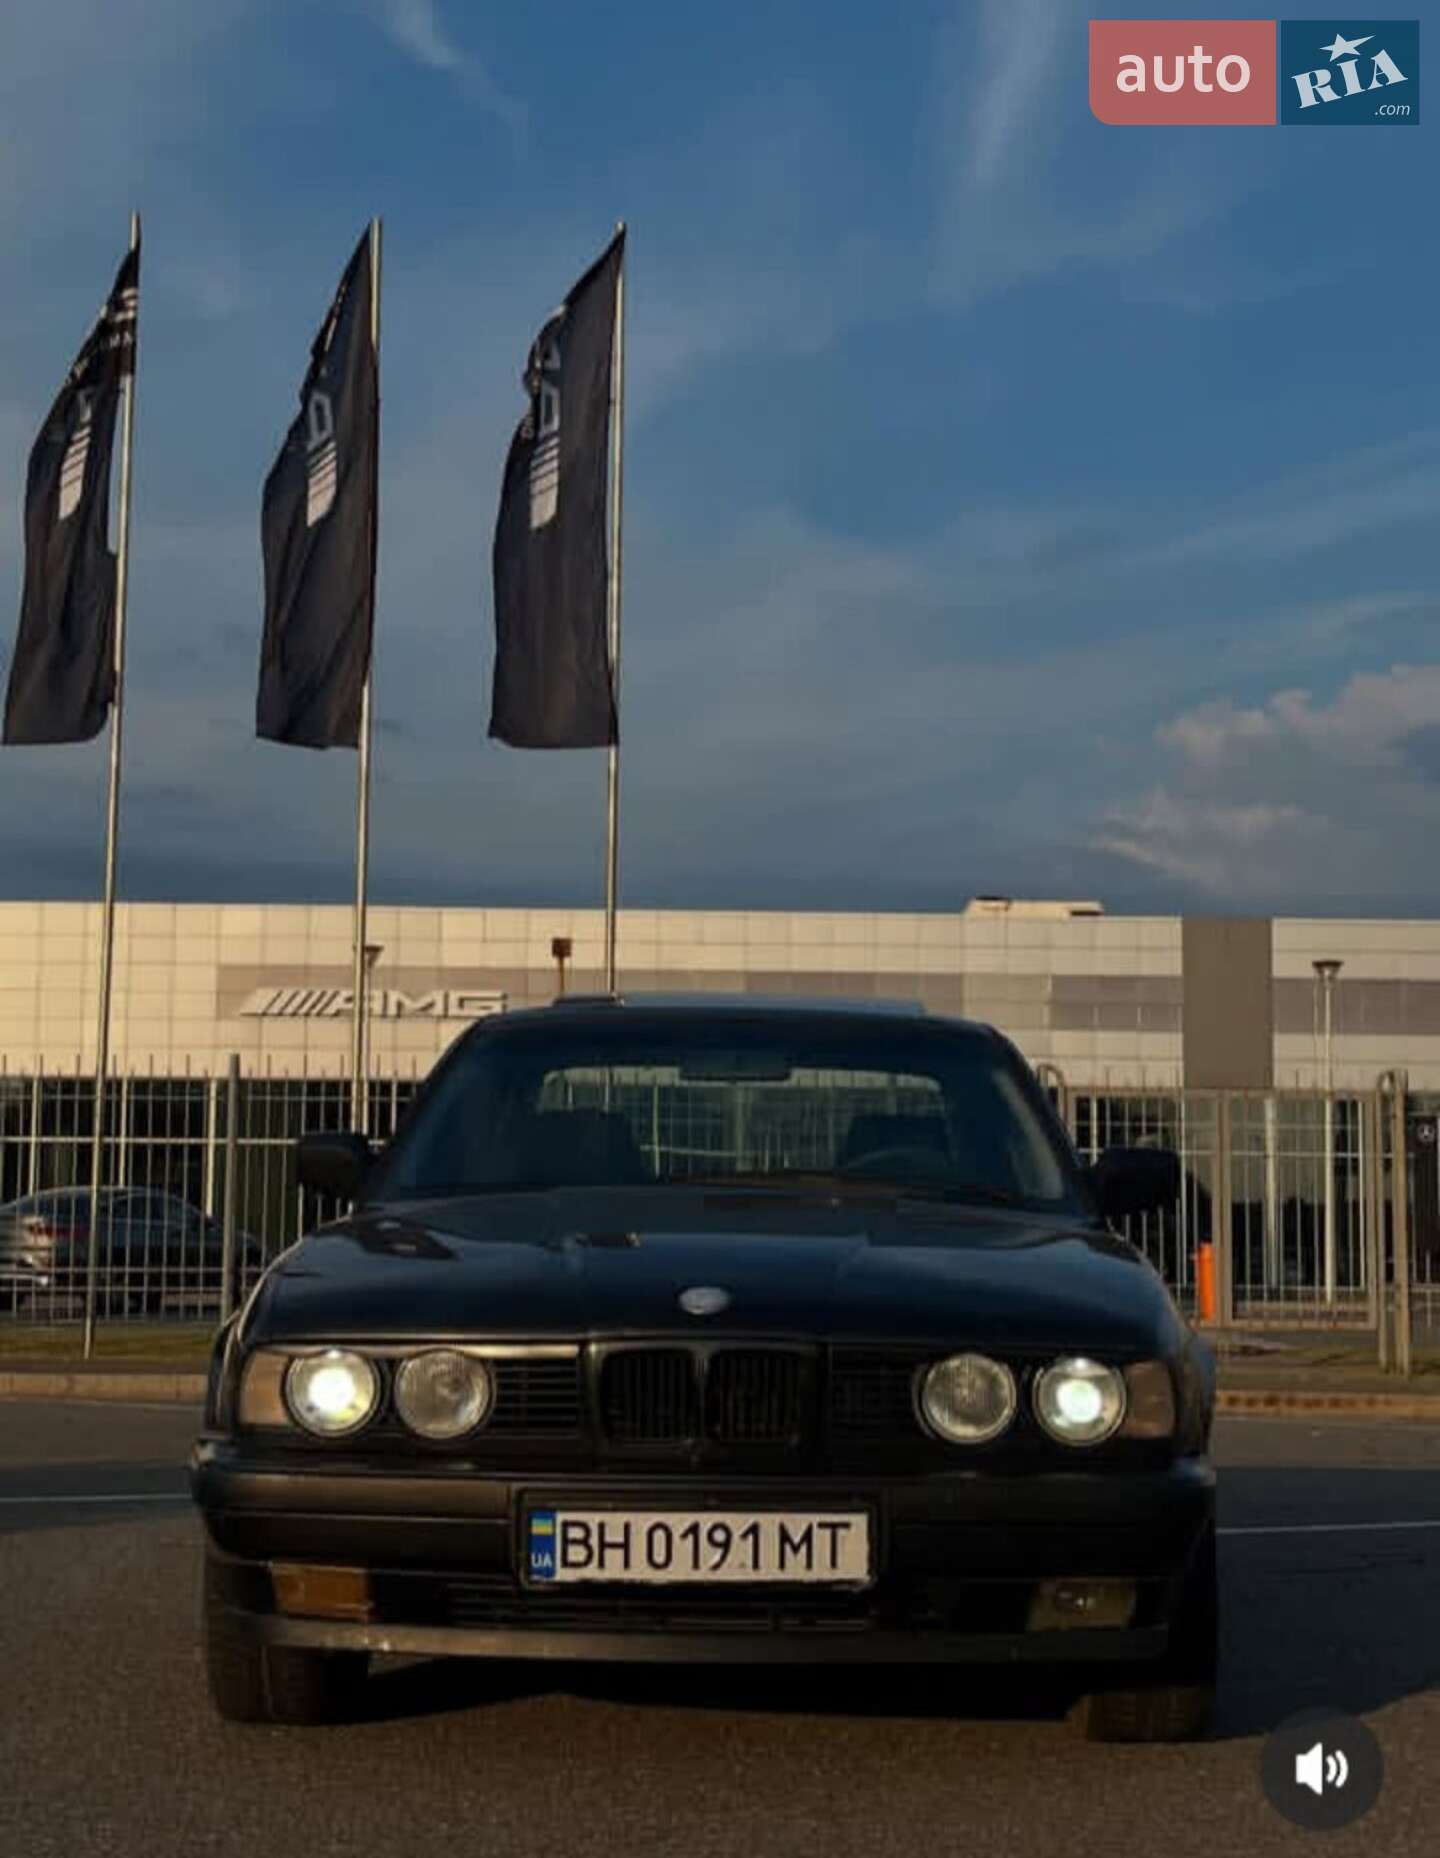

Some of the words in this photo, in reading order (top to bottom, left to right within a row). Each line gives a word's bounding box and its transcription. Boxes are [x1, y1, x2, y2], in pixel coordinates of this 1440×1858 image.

[531, 1552, 551, 1568] UA
[560, 1519, 631, 1571] BH
[646, 1521, 760, 1571] 0191
[779, 1520, 853, 1571] MT
